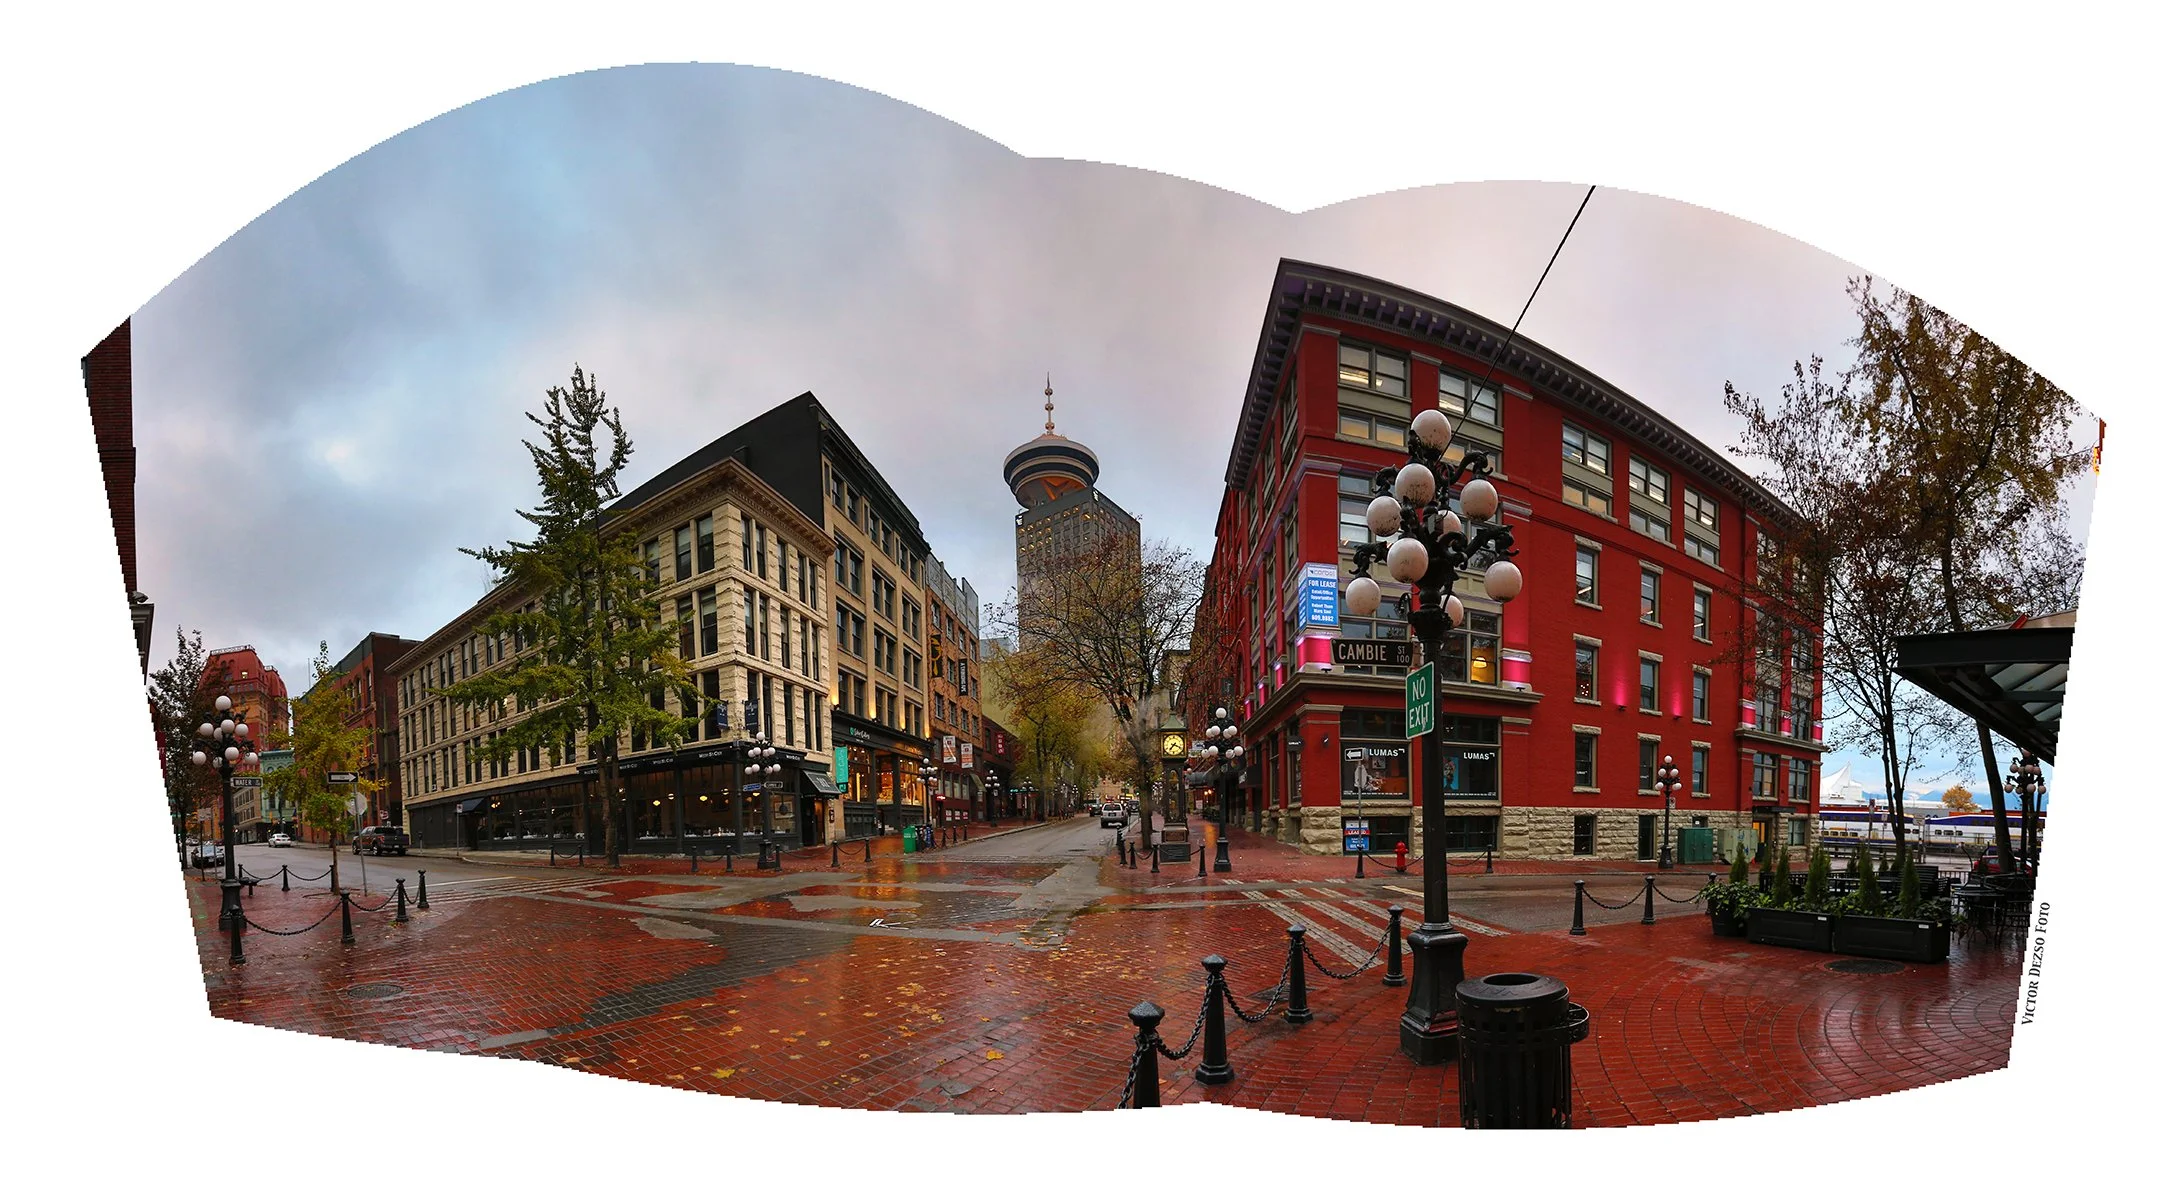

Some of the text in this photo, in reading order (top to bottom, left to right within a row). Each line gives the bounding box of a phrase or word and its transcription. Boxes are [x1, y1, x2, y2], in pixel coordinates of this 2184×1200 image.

[1320, 580, 1337, 589] LEASE
[1338, 643, 1406, 661] CAMBIE ST
[1396, 655, 1410, 664] 100
[1412, 676, 1426, 702] NO
[1409, 701, 1430, 729] EXIT
[1369, 748, 1399, 757] LUMAS
[1463, 752, 1490, 760] LUMAS
